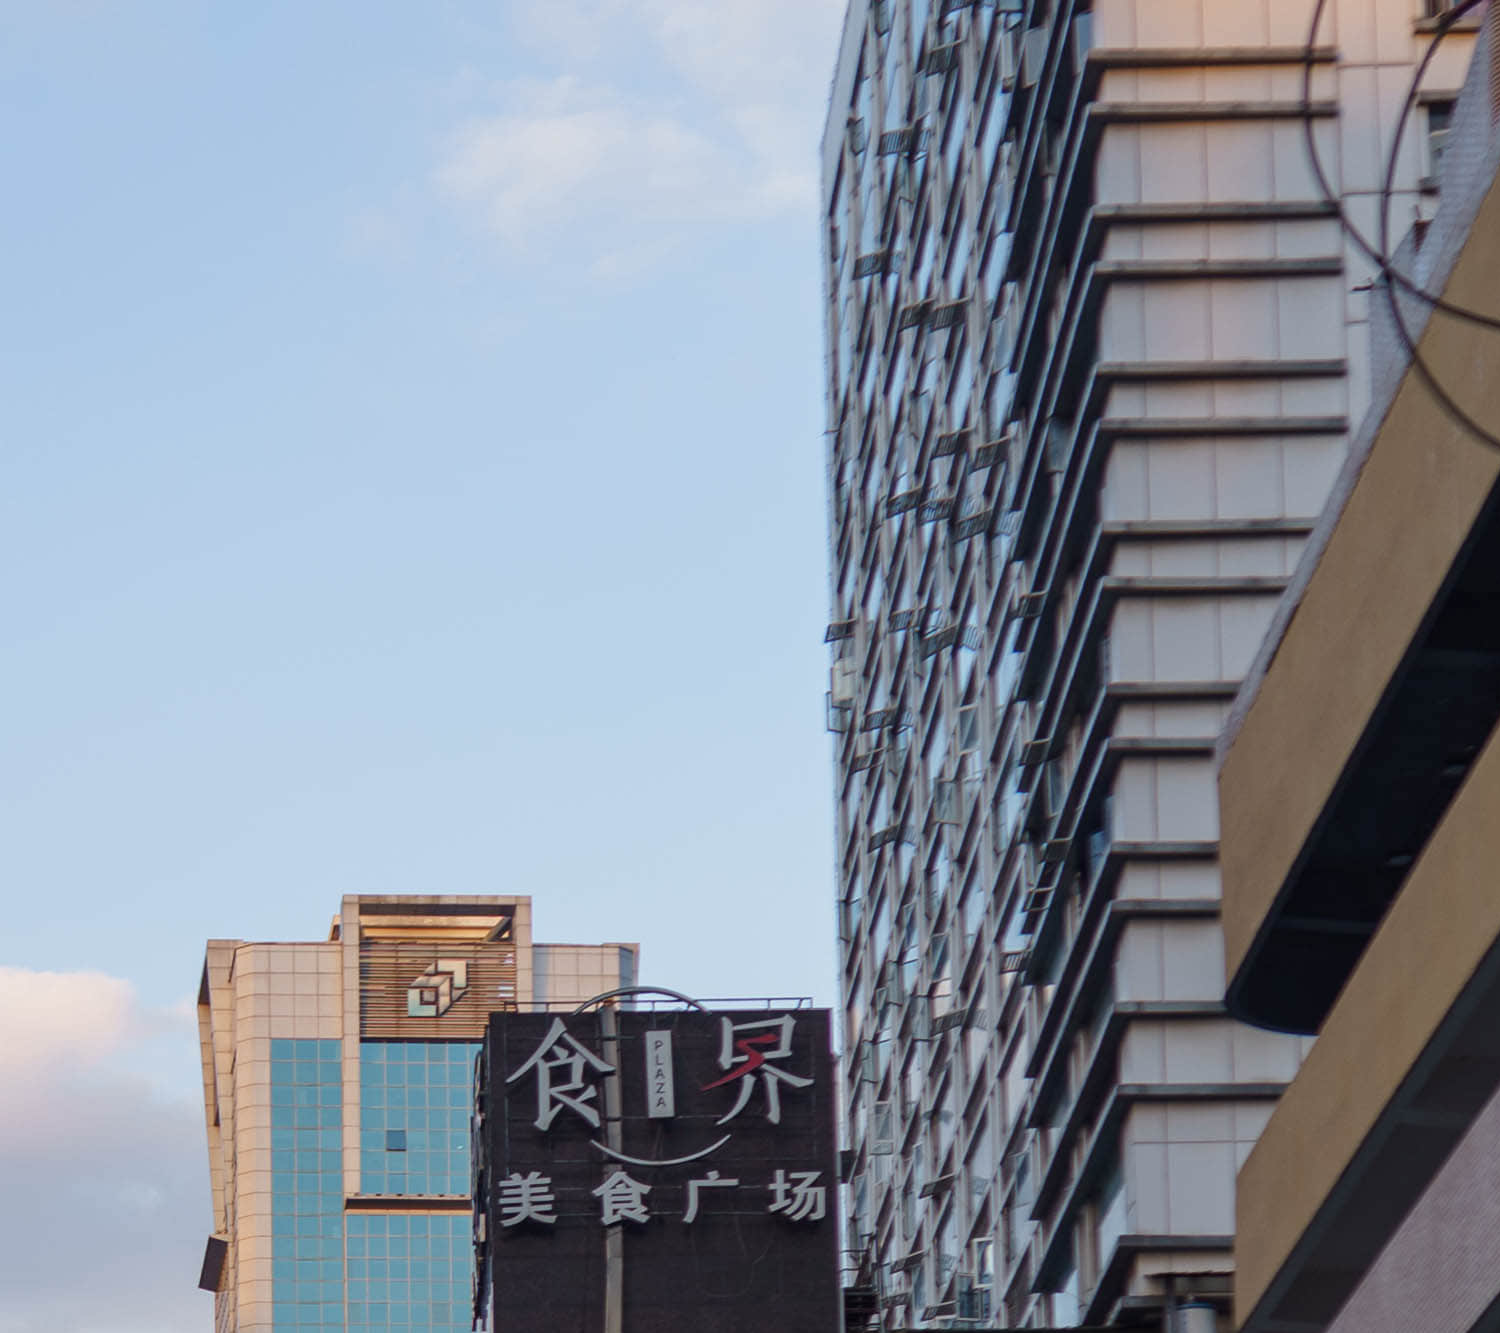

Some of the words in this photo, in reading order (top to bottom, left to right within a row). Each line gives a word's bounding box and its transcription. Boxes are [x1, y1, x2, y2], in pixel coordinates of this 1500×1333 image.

[653, 1040, 668, 1110] PLAZA
[500, 1170, 827, 1227] 美食广场
